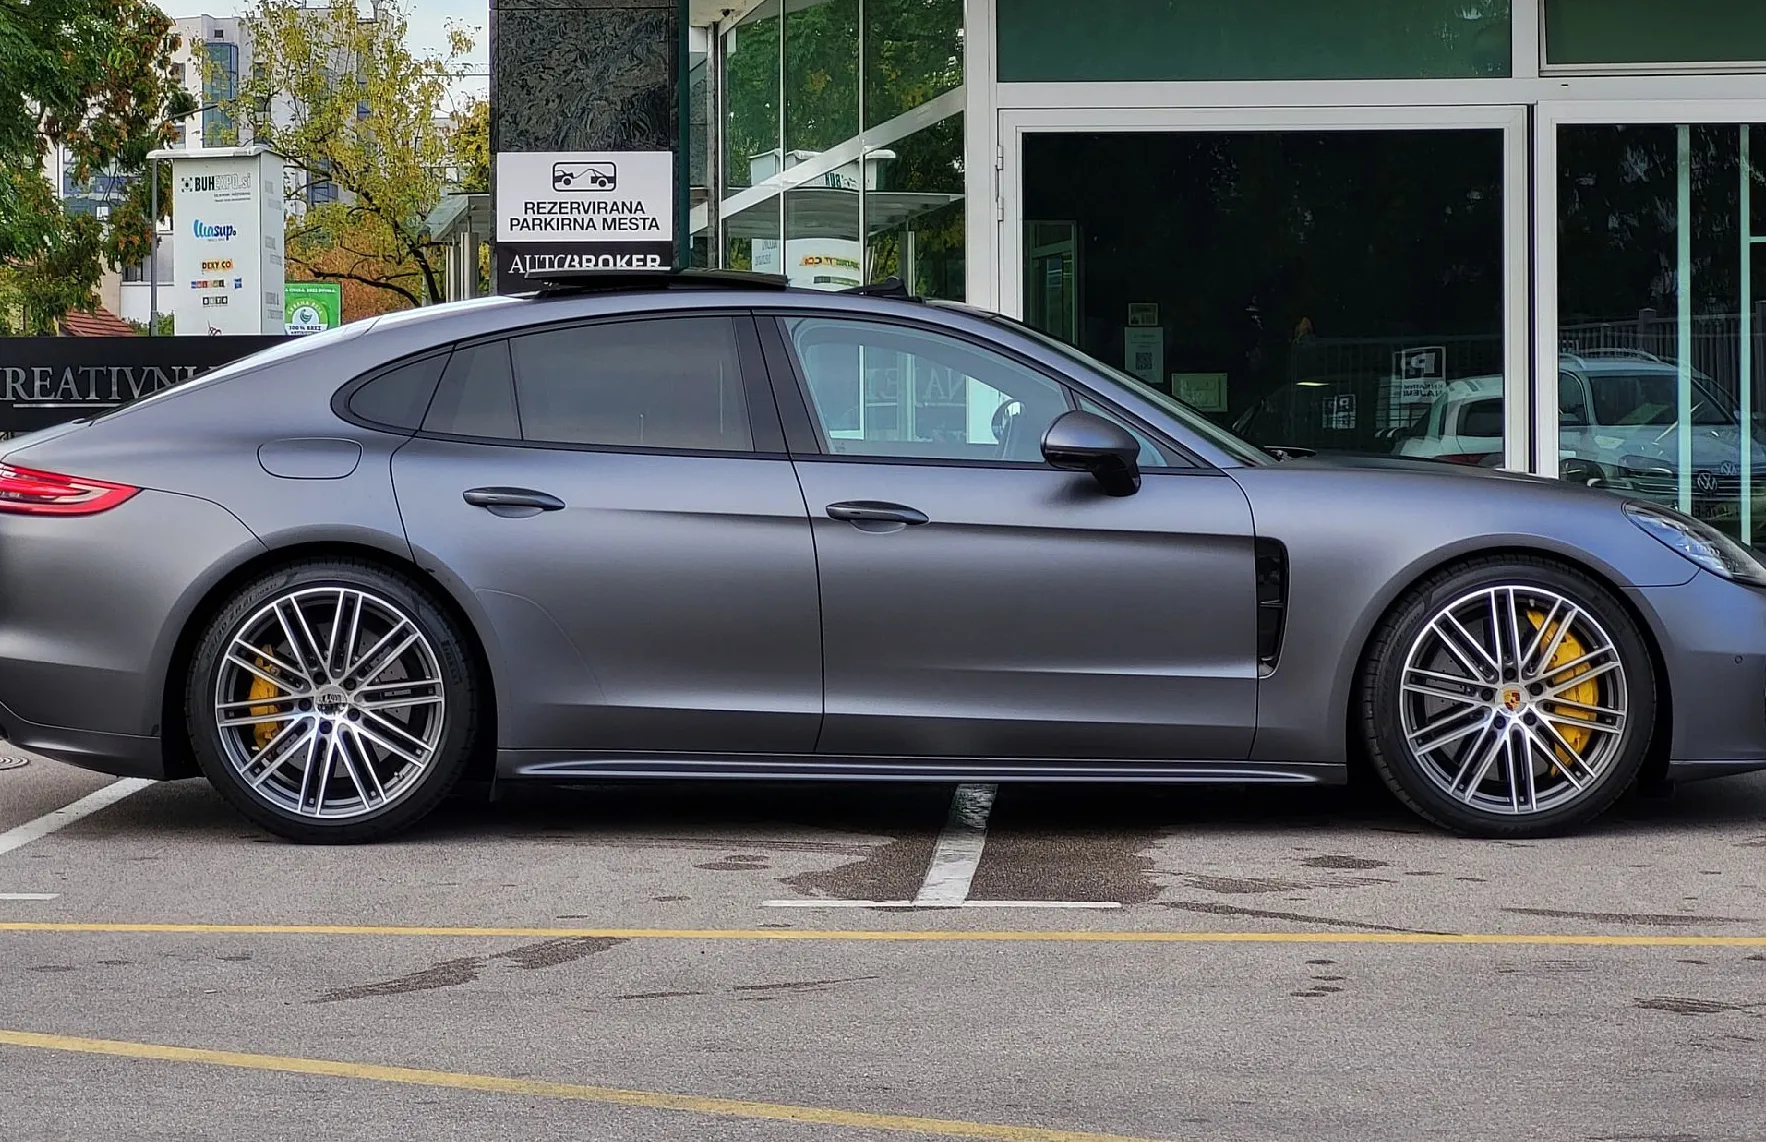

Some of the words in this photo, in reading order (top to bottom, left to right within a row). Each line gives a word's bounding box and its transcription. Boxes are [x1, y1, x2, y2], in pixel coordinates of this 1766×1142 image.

[524, 201, 645, 215] REZERVIRANA
[509, 217, 597, 231] PARKIRNA
[602, 217, 660, 231] MESTA
[202, 261, 220, 270] DEXY
